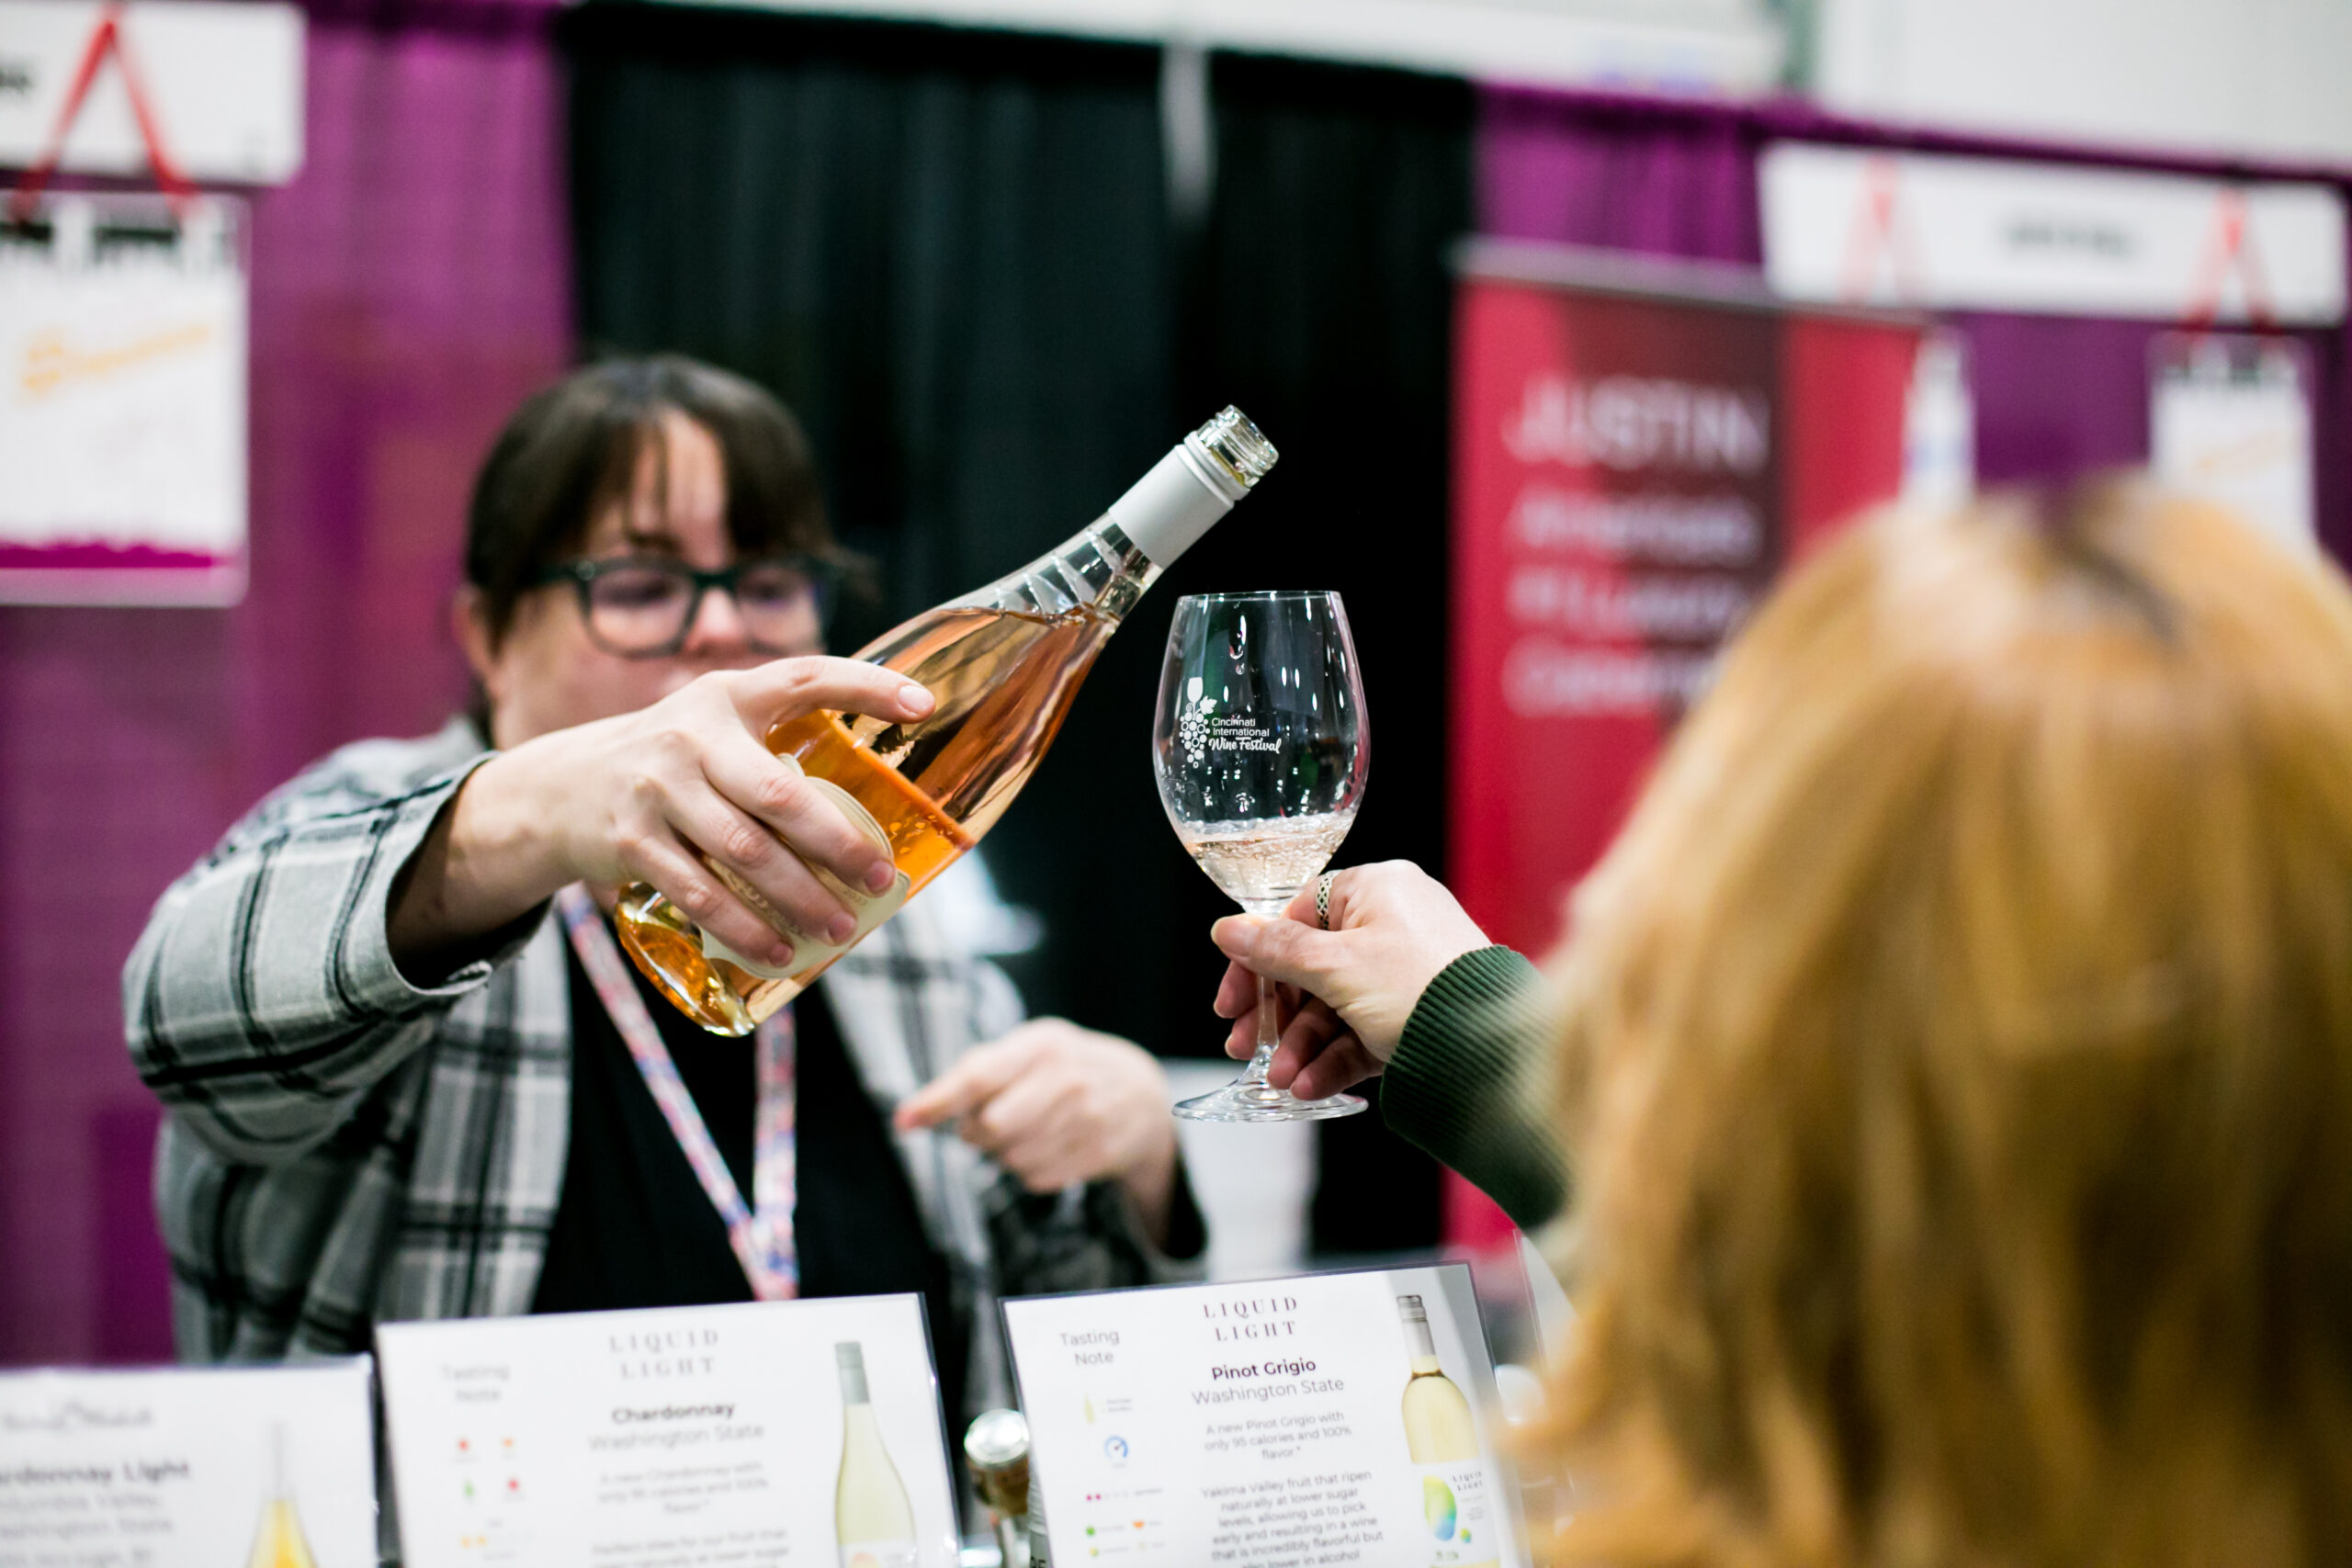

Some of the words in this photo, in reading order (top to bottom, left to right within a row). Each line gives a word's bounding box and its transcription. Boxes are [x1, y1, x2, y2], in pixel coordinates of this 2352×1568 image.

[1503, 378, 1770, 471] JUSTIN
[1211, 717, 1256, 727] Cincinnati
[1213, 728, 1270, 737] International
[1208, 738, 1238, 751] Wine
[1236, 737, 1283, 754] Festival
[1203, 1296, 1297, 1319] LIQUID
[609, 1329, 718, 1353] LIQUID
[1059, 1329, 1121, 1347] Tasting
[1215, 1321, 1295, 1341] LIGHT
[621, 1357, 713, 1379] LIGHT
[1074, 1350, 1114, 1366] Note
[1212, 1364, 1260, 1381] Pinot
[1263, 1358, 1317, 1376] Grigio
[1192, 1384, 1297, 1404] Washington
[1301, 1379, 1345, 1393] State
[611, 1403, 736, 1424] Chardonnay
[1218, 1423, 1243, 1434] new
[1247, 1418, 1277, 1431] Pinot
[1281, 1415, 1316, 1428] Grigio
[1318, 1411, 1345, 1424] with
[589, 1428, 709, 1450] Washington
[715, 1425, 764, 1441] State
[1204, 1438, 1229, 1451] only
[1250, 1432, 1295, 1446] calories
[1297, 1428, 1320, 1441] and
[1322, 1426, 1352, 1438] 100%
[1249, 1480, 1285, 1494] Valley
[1287, 1477, 1313, 1489] fruit
[1315, 1473, 1339, 1485] that
[1341, 1470, 1373, 1483] ripen
[1221, 1497, 1273, 1512] naturally
[1276, 1495, 1288, 1506] at
[1291, 1491, 1323, 1505] lower
[1327, 1488, 1359, 1502] sugar
[1258, 1508, 1308, 1523] allowing
[1311, 1506, 1324, 1517] us
[1327, 1505, 1340, 1516] to
[1342, 1501, 1367, 1516] pick
[1213, 1531, 1241, 1545] early
[1245, 1529, 1268, 1541] and
[1271, 1521, 1323, 1538] resulting
[1326, 1519, 1338, 1530] in
[1350, 1516, 1378, 1529] wine
[1212, 1548, 1237, 1561] that
[1239, 1546, 1250, 1558] is
[1252, 1540, 1310, 1557] incredibly
[1313, 1533, 1361, 1549] flavorful
[1363, 1530, 1384, 1543] but
[1304, 1554, 1316, 1566] in
[1317, 1550, 1360, 1565] alcohol
